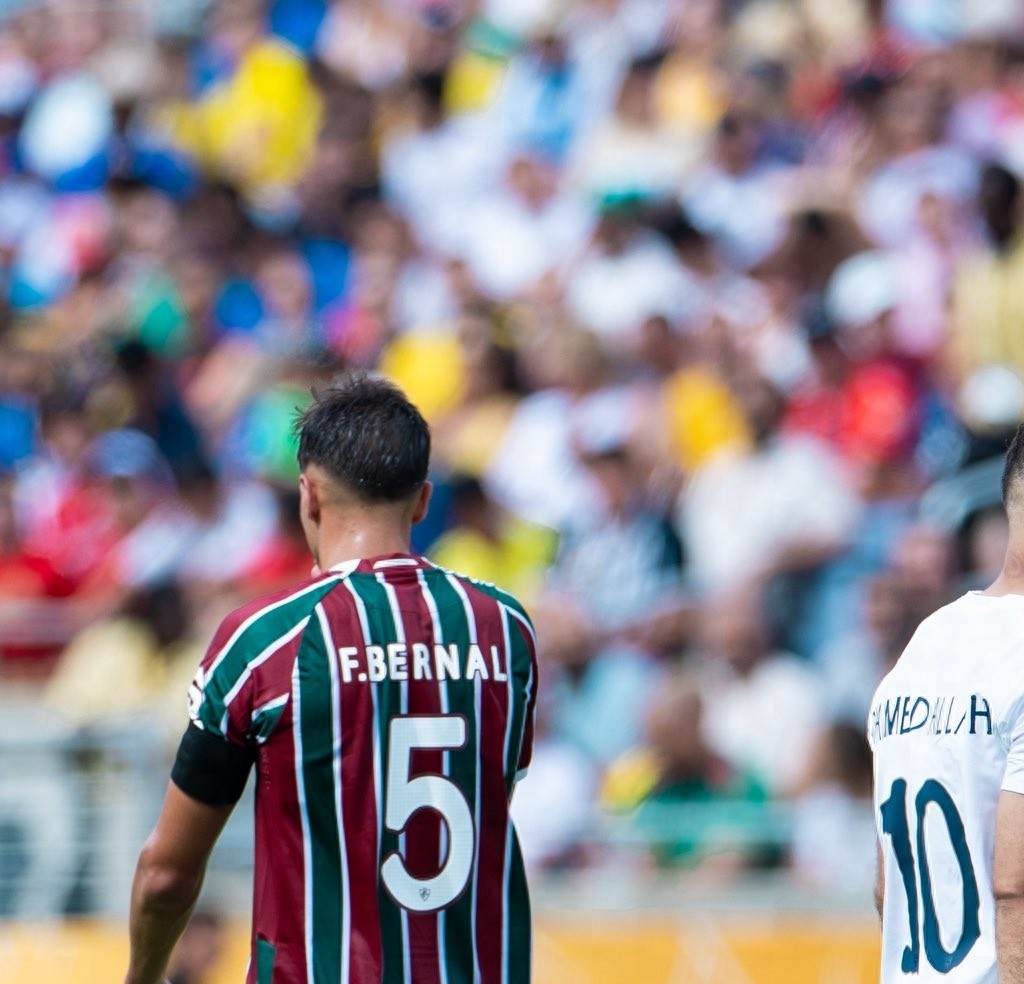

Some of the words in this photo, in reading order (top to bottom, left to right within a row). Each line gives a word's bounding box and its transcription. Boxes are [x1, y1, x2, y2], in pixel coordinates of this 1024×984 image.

[339, 643, 508, 683] F.BERNAL
[380, 716, 475, 912] 5
[880, 778, 981, 974] 10
